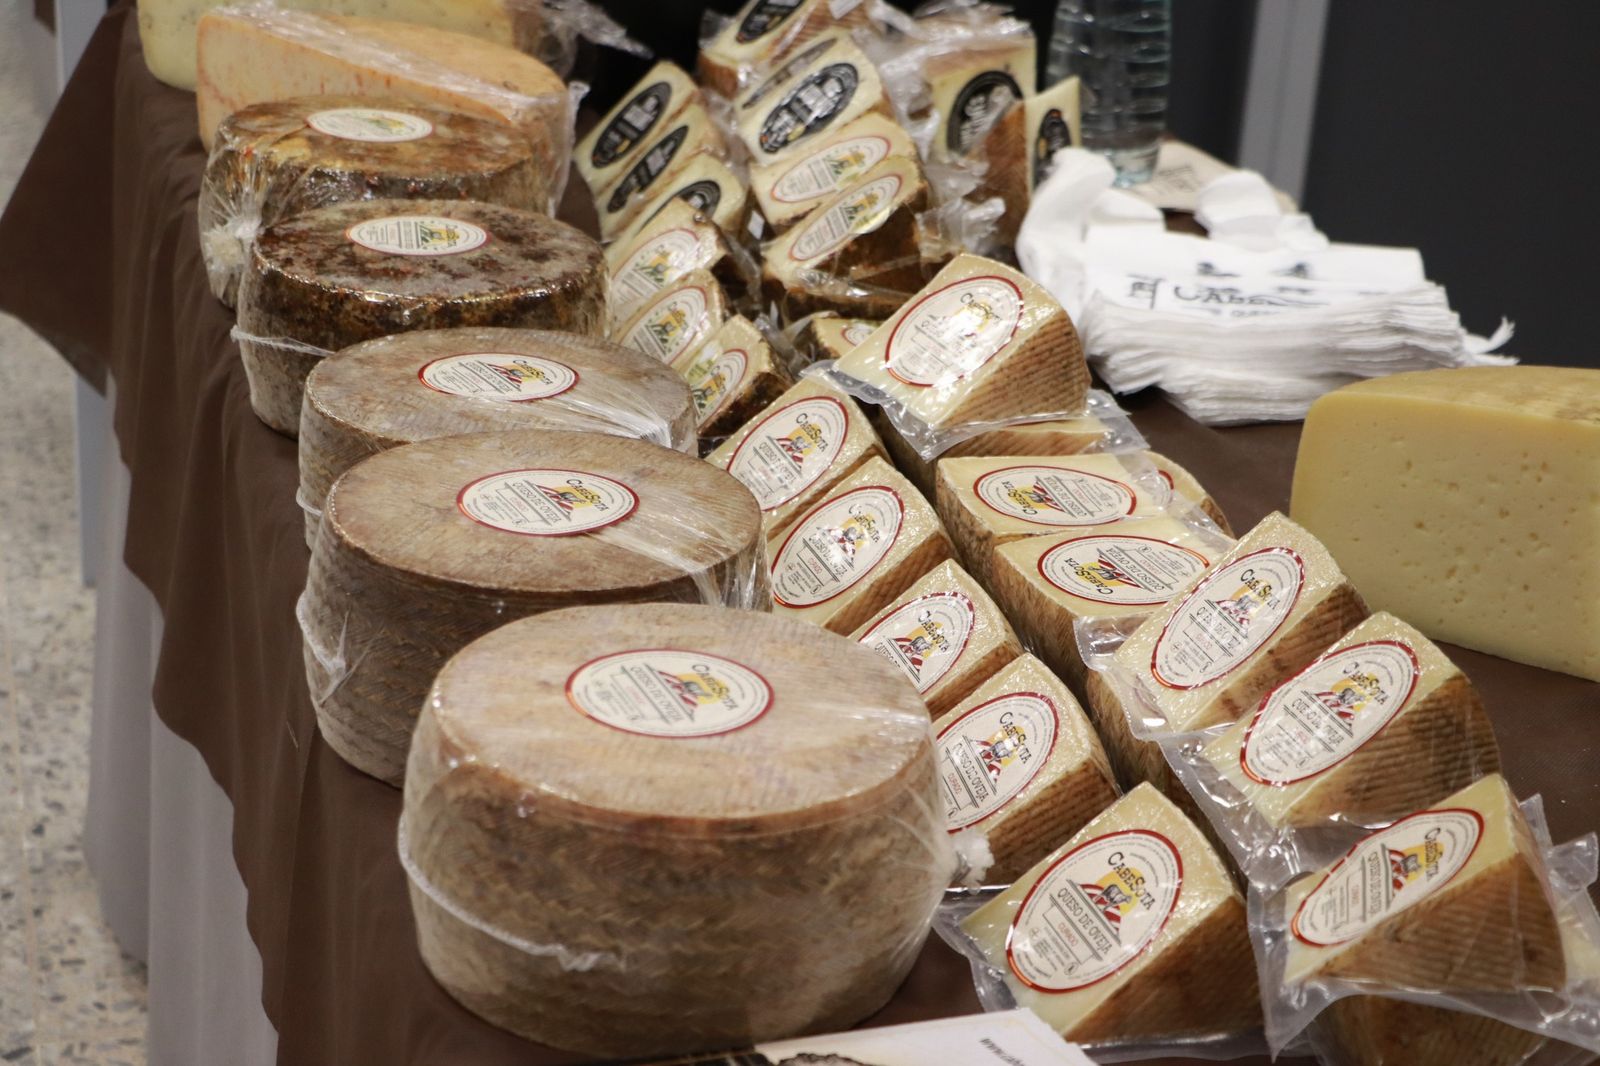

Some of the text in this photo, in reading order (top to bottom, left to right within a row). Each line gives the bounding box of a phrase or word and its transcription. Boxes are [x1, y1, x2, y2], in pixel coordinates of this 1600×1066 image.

[512, 481, 536, 502] QUESO
[566, 478, 609, 512] CABESOTA
[1001, 480, 1037, 516] CABESOTA
[1064, 557, 1114, 595] CABESOTA
[1105, 547, 1165, 591] QUESO DE OVEJA
[691, 663, 739, 711] CABESOTA
[1107, 851, 1156, 911] CABESOTA
[1056, 887, 1114, 955] QUESO DE OVEJA
